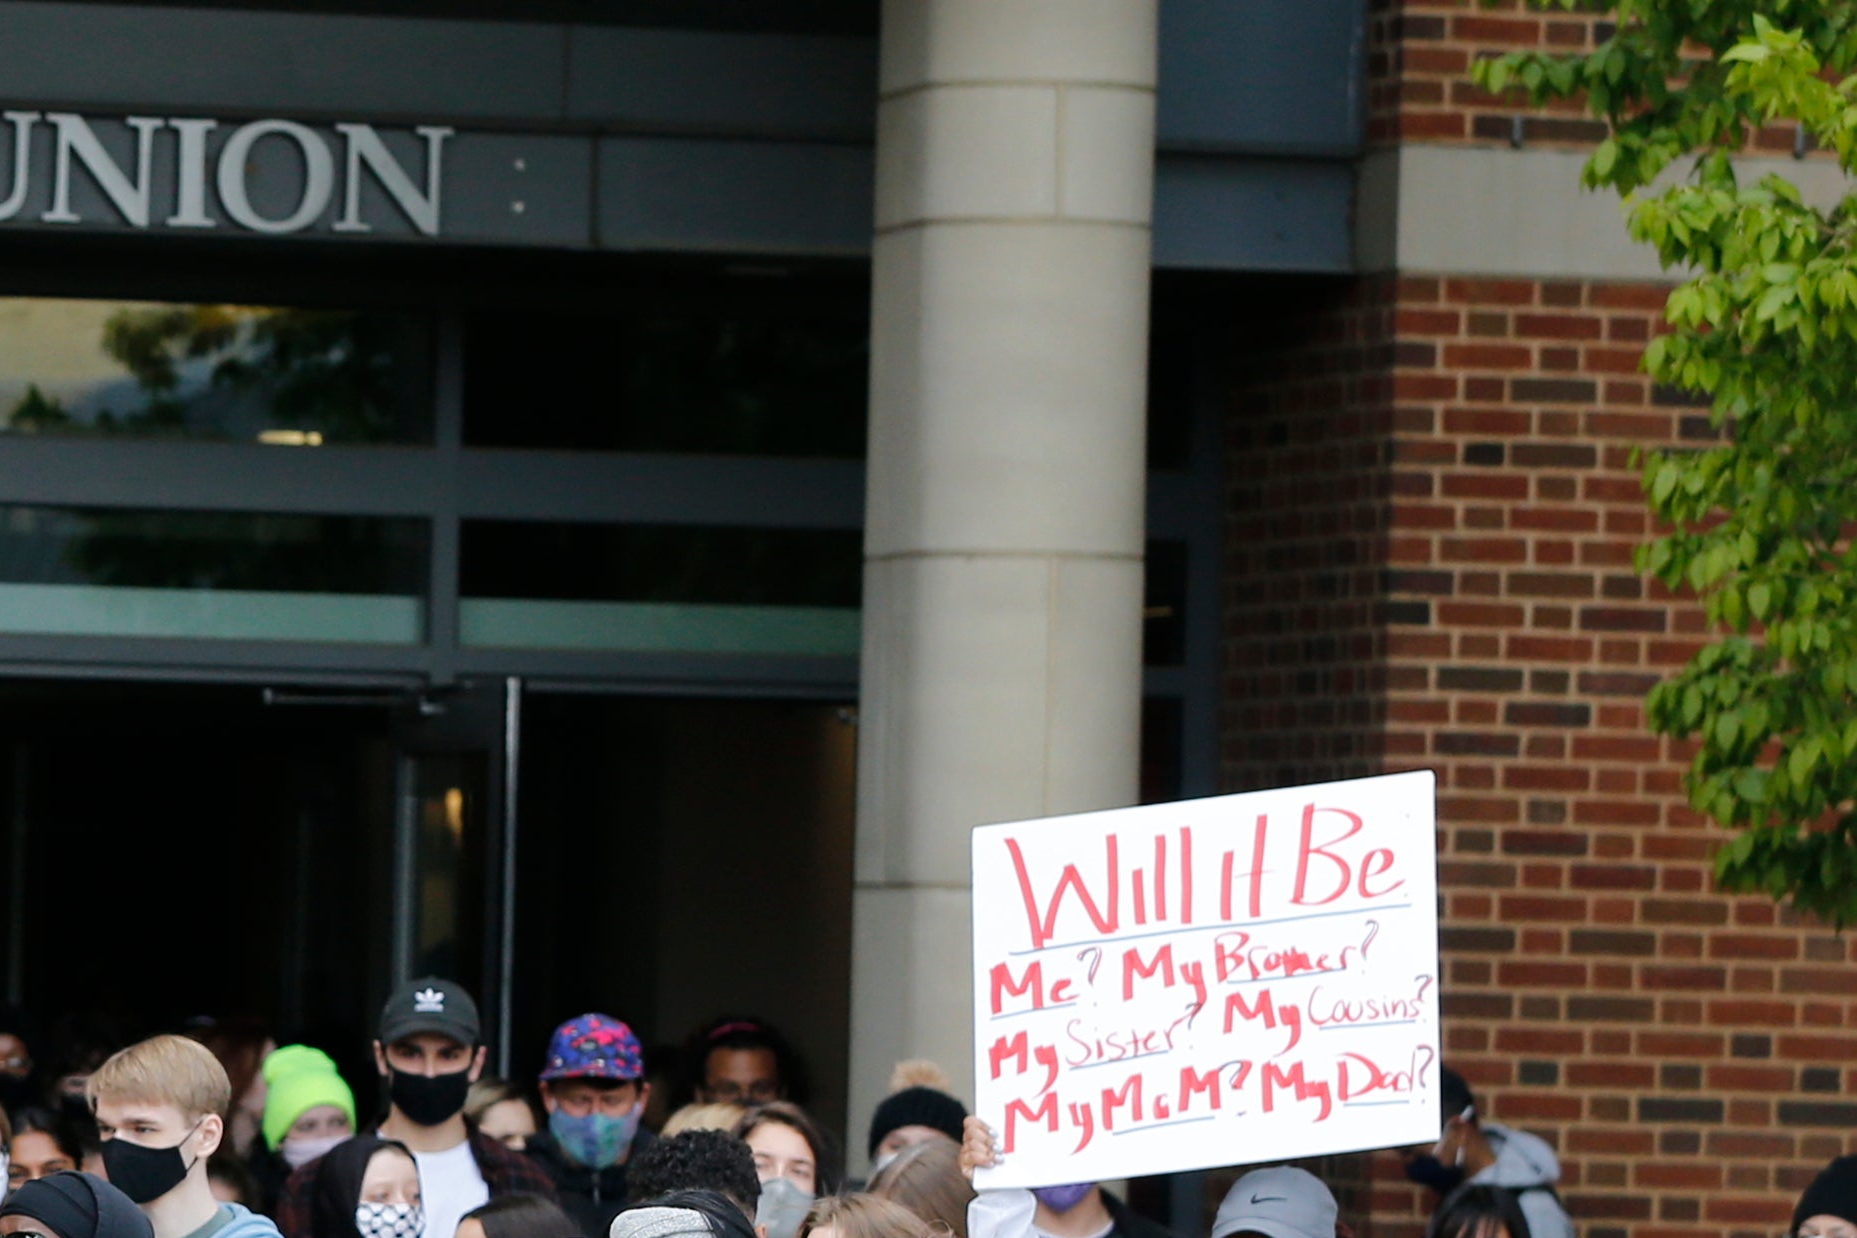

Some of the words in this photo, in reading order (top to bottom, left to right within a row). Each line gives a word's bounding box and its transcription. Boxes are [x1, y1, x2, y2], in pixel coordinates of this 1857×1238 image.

[1003, 826, 1193, 950] Will
[1288, 801, 1407, 907] Be
[988, 1029, 1060, 1099] My
[1064, 1000, 1203, 1067] Sister?
[1222, 988, 1303, 1057] My
[1306, 974, 1434, 1026] Cousins?
[989, 946, 1104, 1016] Me?
[1121, 942, 1209, 1005] My
[1003, 1090, 1095, 1156] My
[1260, 1060, 1333, 1123] My
[1336, 1043, 1436, 1104] Dad?
